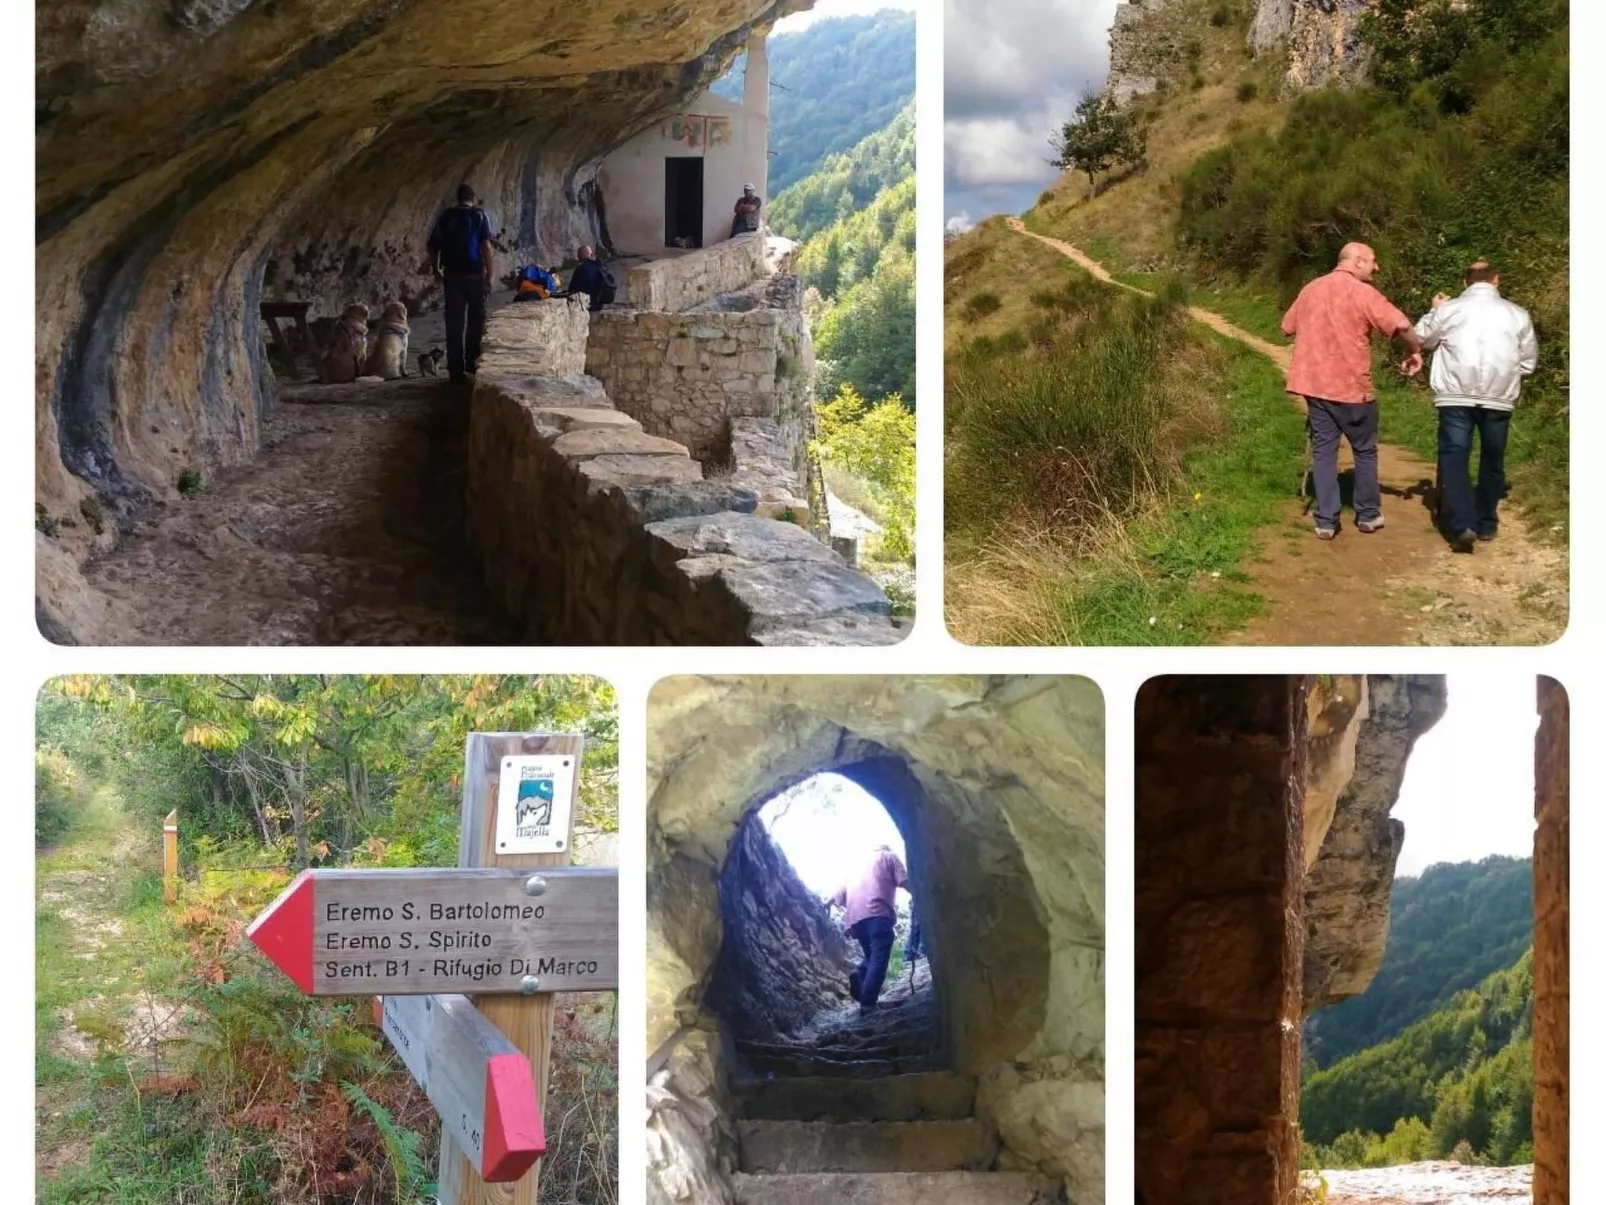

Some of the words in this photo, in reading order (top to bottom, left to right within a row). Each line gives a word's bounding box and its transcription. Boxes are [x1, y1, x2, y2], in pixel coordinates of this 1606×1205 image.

[327, 903, 393, 921] Eremo
[401, 903, 420, 920] S.
[430, 903, 545, 920] Bartolomeo
[327, 933, 391, 950] Eremo
[399, 933, 419, 950] S.
[429, 931, 492, 951] Spirito
[325, 961, 377, 978] Sent.
[386, 961, 409, 977] B1
[434, 959, 502, 980] Rifugio
[510, 960, 530, 975] Di
[538, 958, 597, 975] Marco
